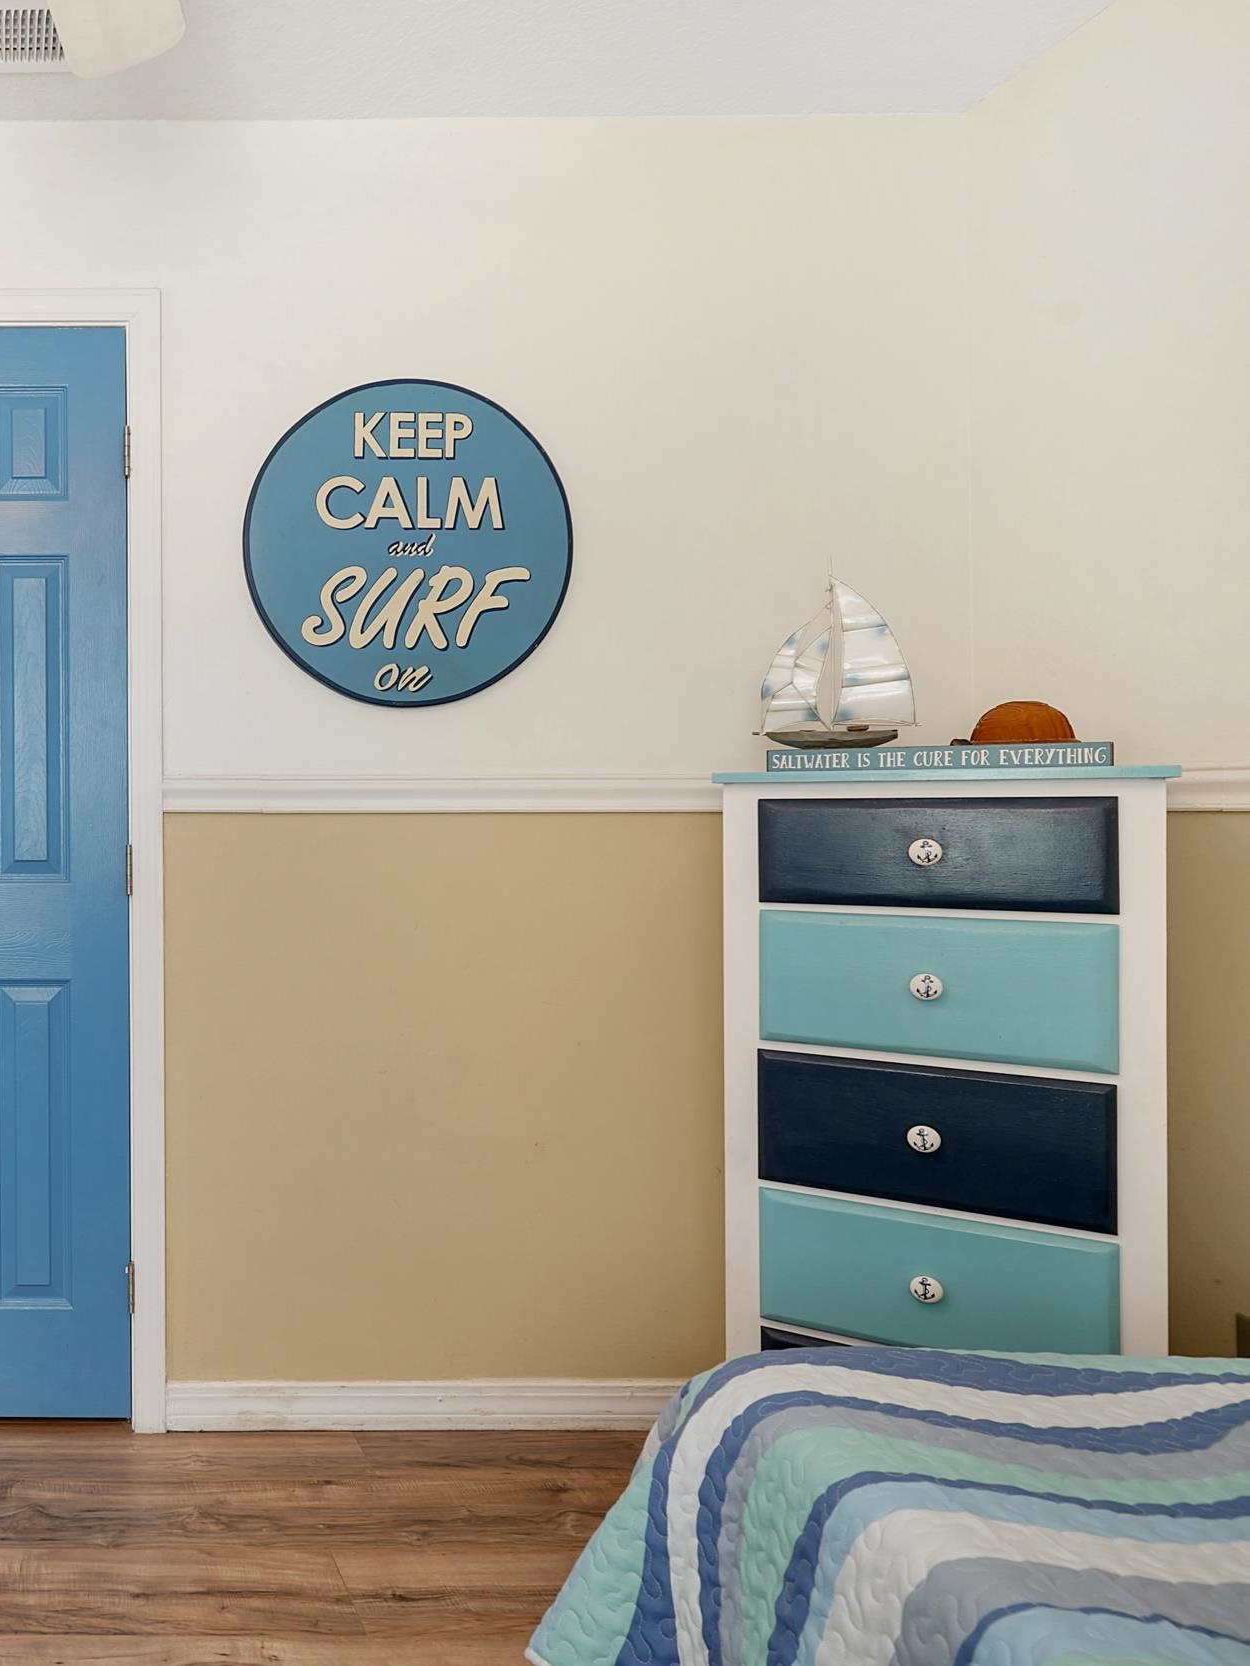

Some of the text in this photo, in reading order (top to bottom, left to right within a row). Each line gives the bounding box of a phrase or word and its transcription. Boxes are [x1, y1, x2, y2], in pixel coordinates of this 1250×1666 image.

[353, 412, 473, 459] KEEP
[315, 475, 505, 530] CALM
[387, 533, 436, 557] and
[301, 565, 531, 649] SURF
[373, 663, 433, 692] on
[772, 747, 1107, 770] SALTWATER IS THE CURE FOR EVERYTHING
